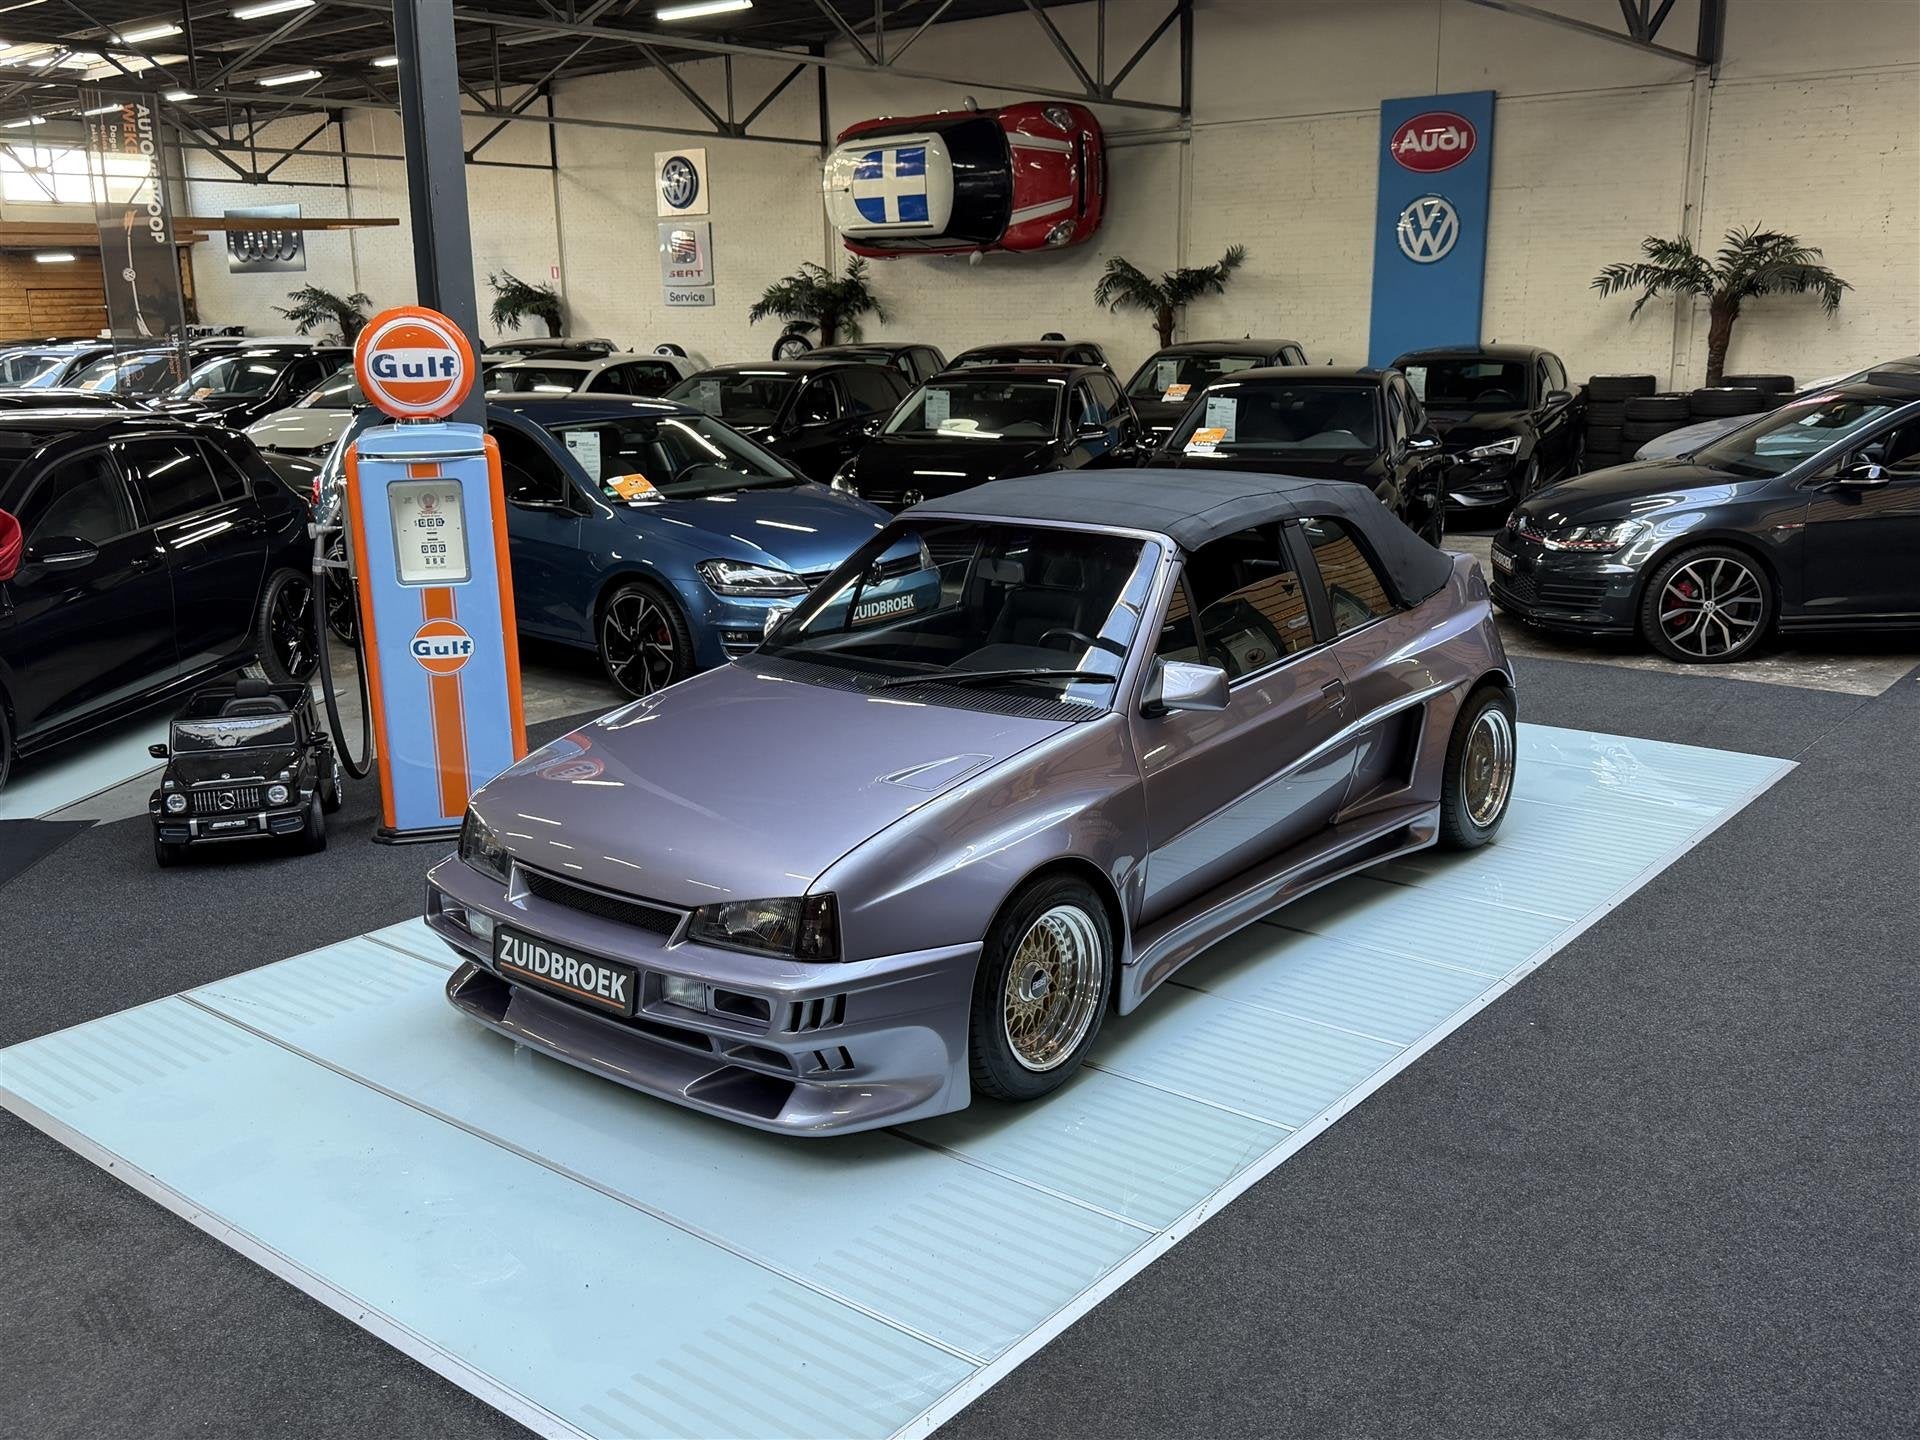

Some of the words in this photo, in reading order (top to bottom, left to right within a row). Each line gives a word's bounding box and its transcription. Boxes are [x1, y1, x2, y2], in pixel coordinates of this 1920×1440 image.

[1399, 126, 1468, 153] Audi
[669, 269, 704, 278] SEAT
[669, 291, 706, 302] Service
[372, 354, 456, 378] Gulf
[853, 594, 915, 620] ZUIDBROEK
[412, 640, 473, 656] Gulf
[500, 934, 627, 1003] ZUIDBROEK
